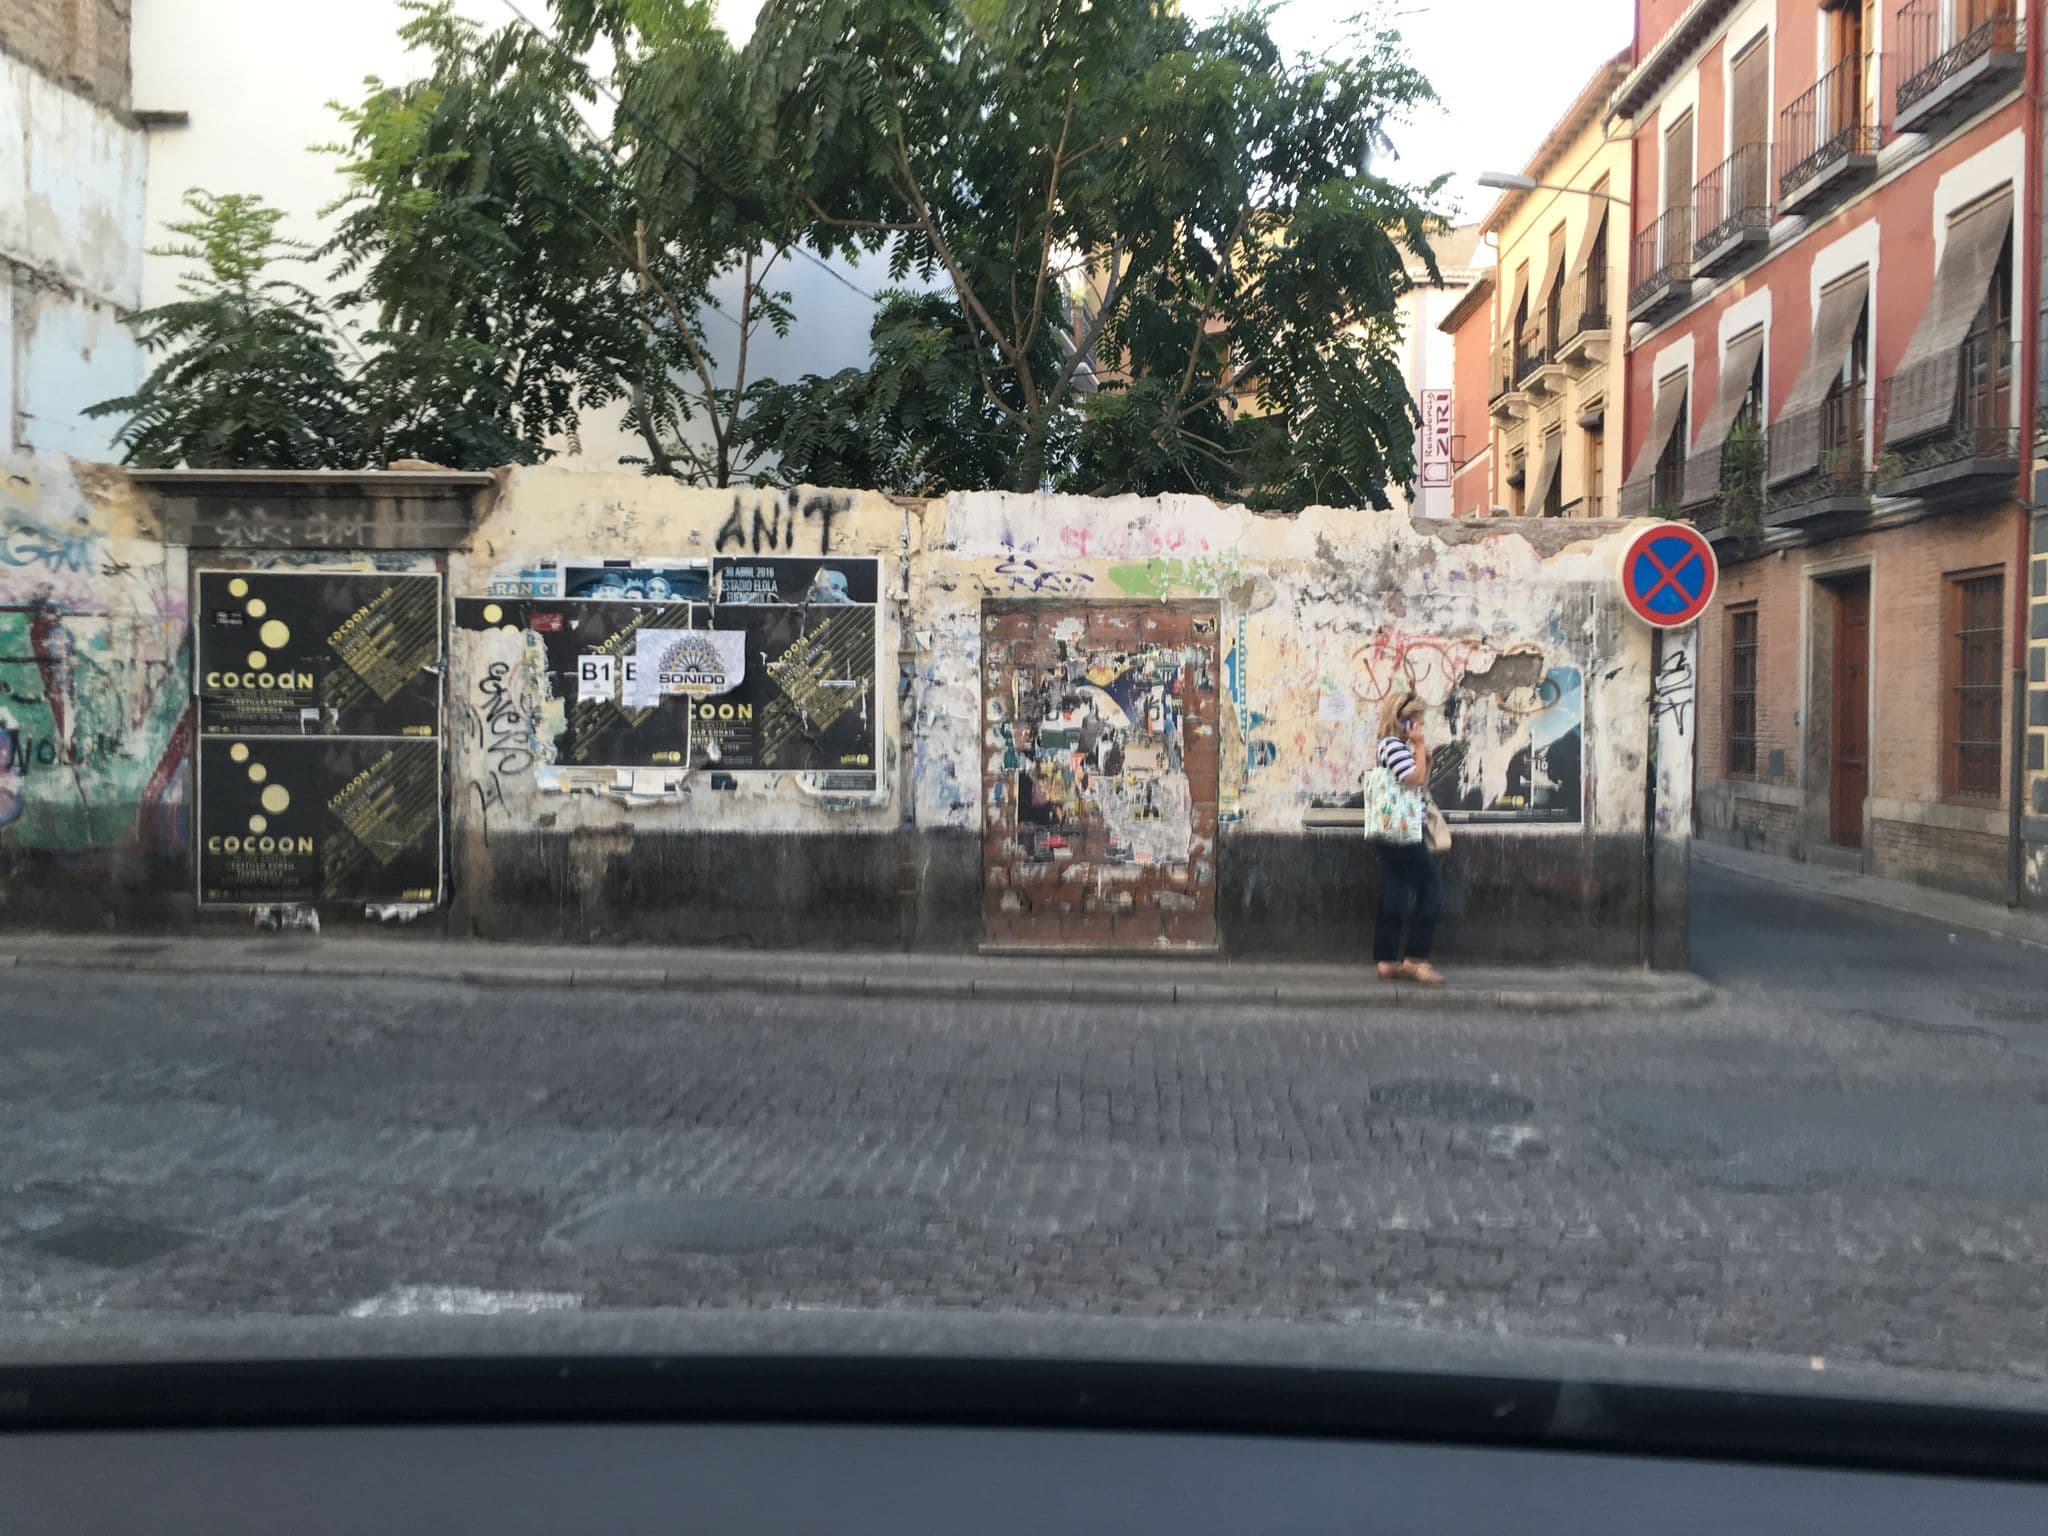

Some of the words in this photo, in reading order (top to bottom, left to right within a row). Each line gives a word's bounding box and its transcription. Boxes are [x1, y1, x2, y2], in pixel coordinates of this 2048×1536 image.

[1425, 393, 1436, 457] Residencia
[1436, 394, 1449, 457] ZIRI
[735, 567, 754, 577] ABRIL
[756, 567, 774, 578] 2016
[722, 580, 752, 591] ESTADIO
[753, 580, 778, 592] ELOLA
[327, 605, 370, 646] COCOON
[206, 672, 314, 689] COCOON
[582, 662, 610, 681] B1
[659, 673, 725, 684] SONIDO
[207, 836, 313, 855] COCOON
